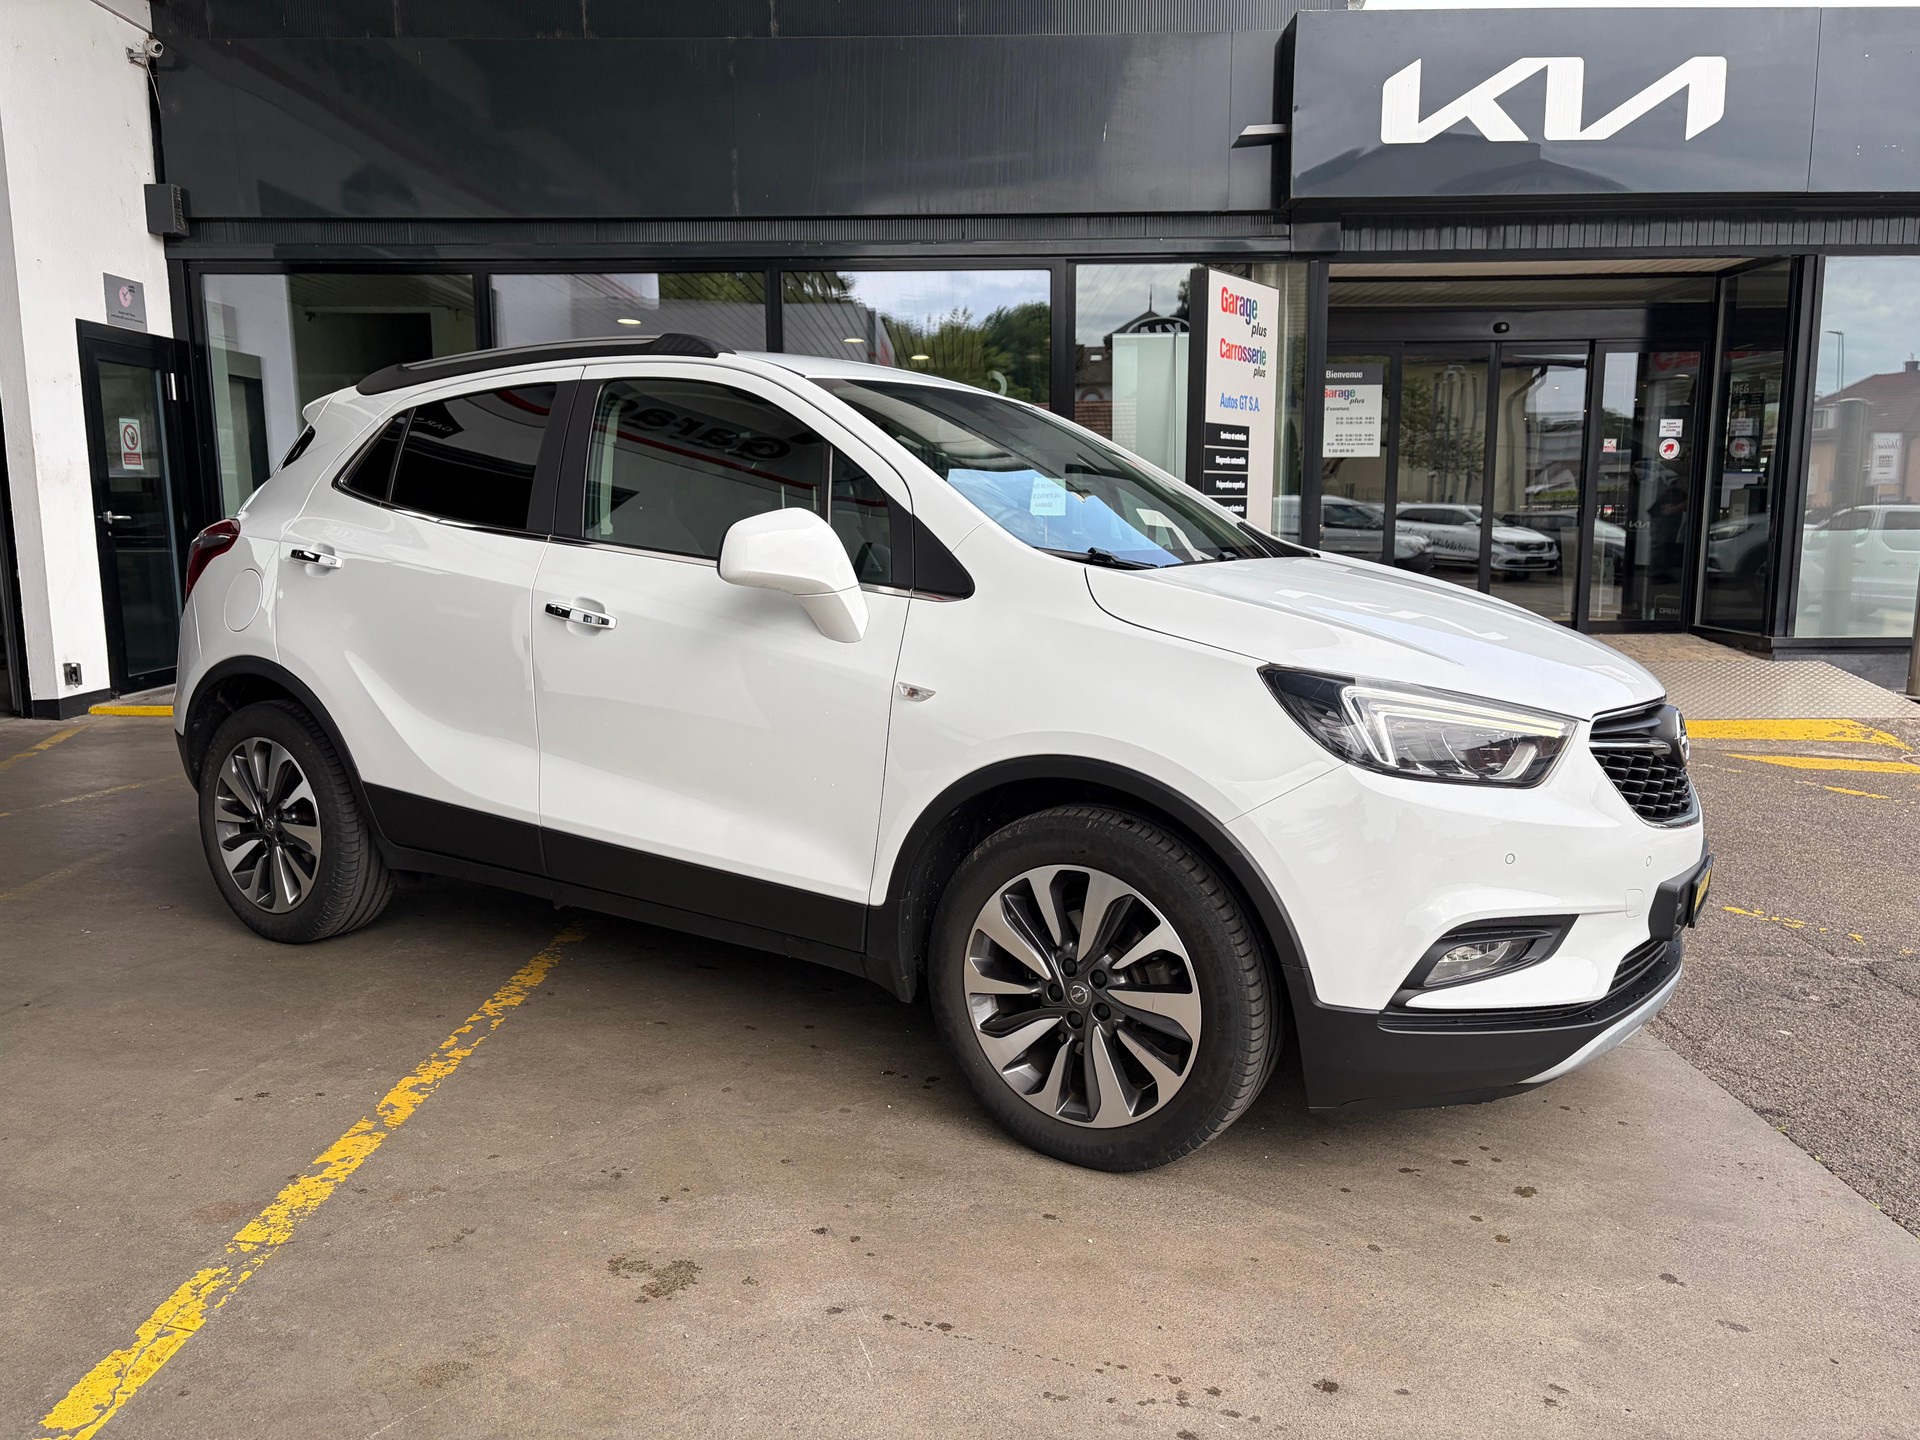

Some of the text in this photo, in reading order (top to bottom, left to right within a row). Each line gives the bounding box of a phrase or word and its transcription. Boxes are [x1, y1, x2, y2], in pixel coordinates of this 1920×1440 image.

[1381, 56, 1727, 144] KIA
[1221, 286, 1258, 325] Garage
[1251, 322, 1267, 338] plus
[1220, 337, 1267, 366] Carrosserie
[1253, 366, 1266, 378] plus
[1325, 370, 1363, 379] Bienvenue
[1220, 392, 1239, 410] Autos
[1240, 394, 1248, 411] GT
[1349, 397, 1365, 405] plus
